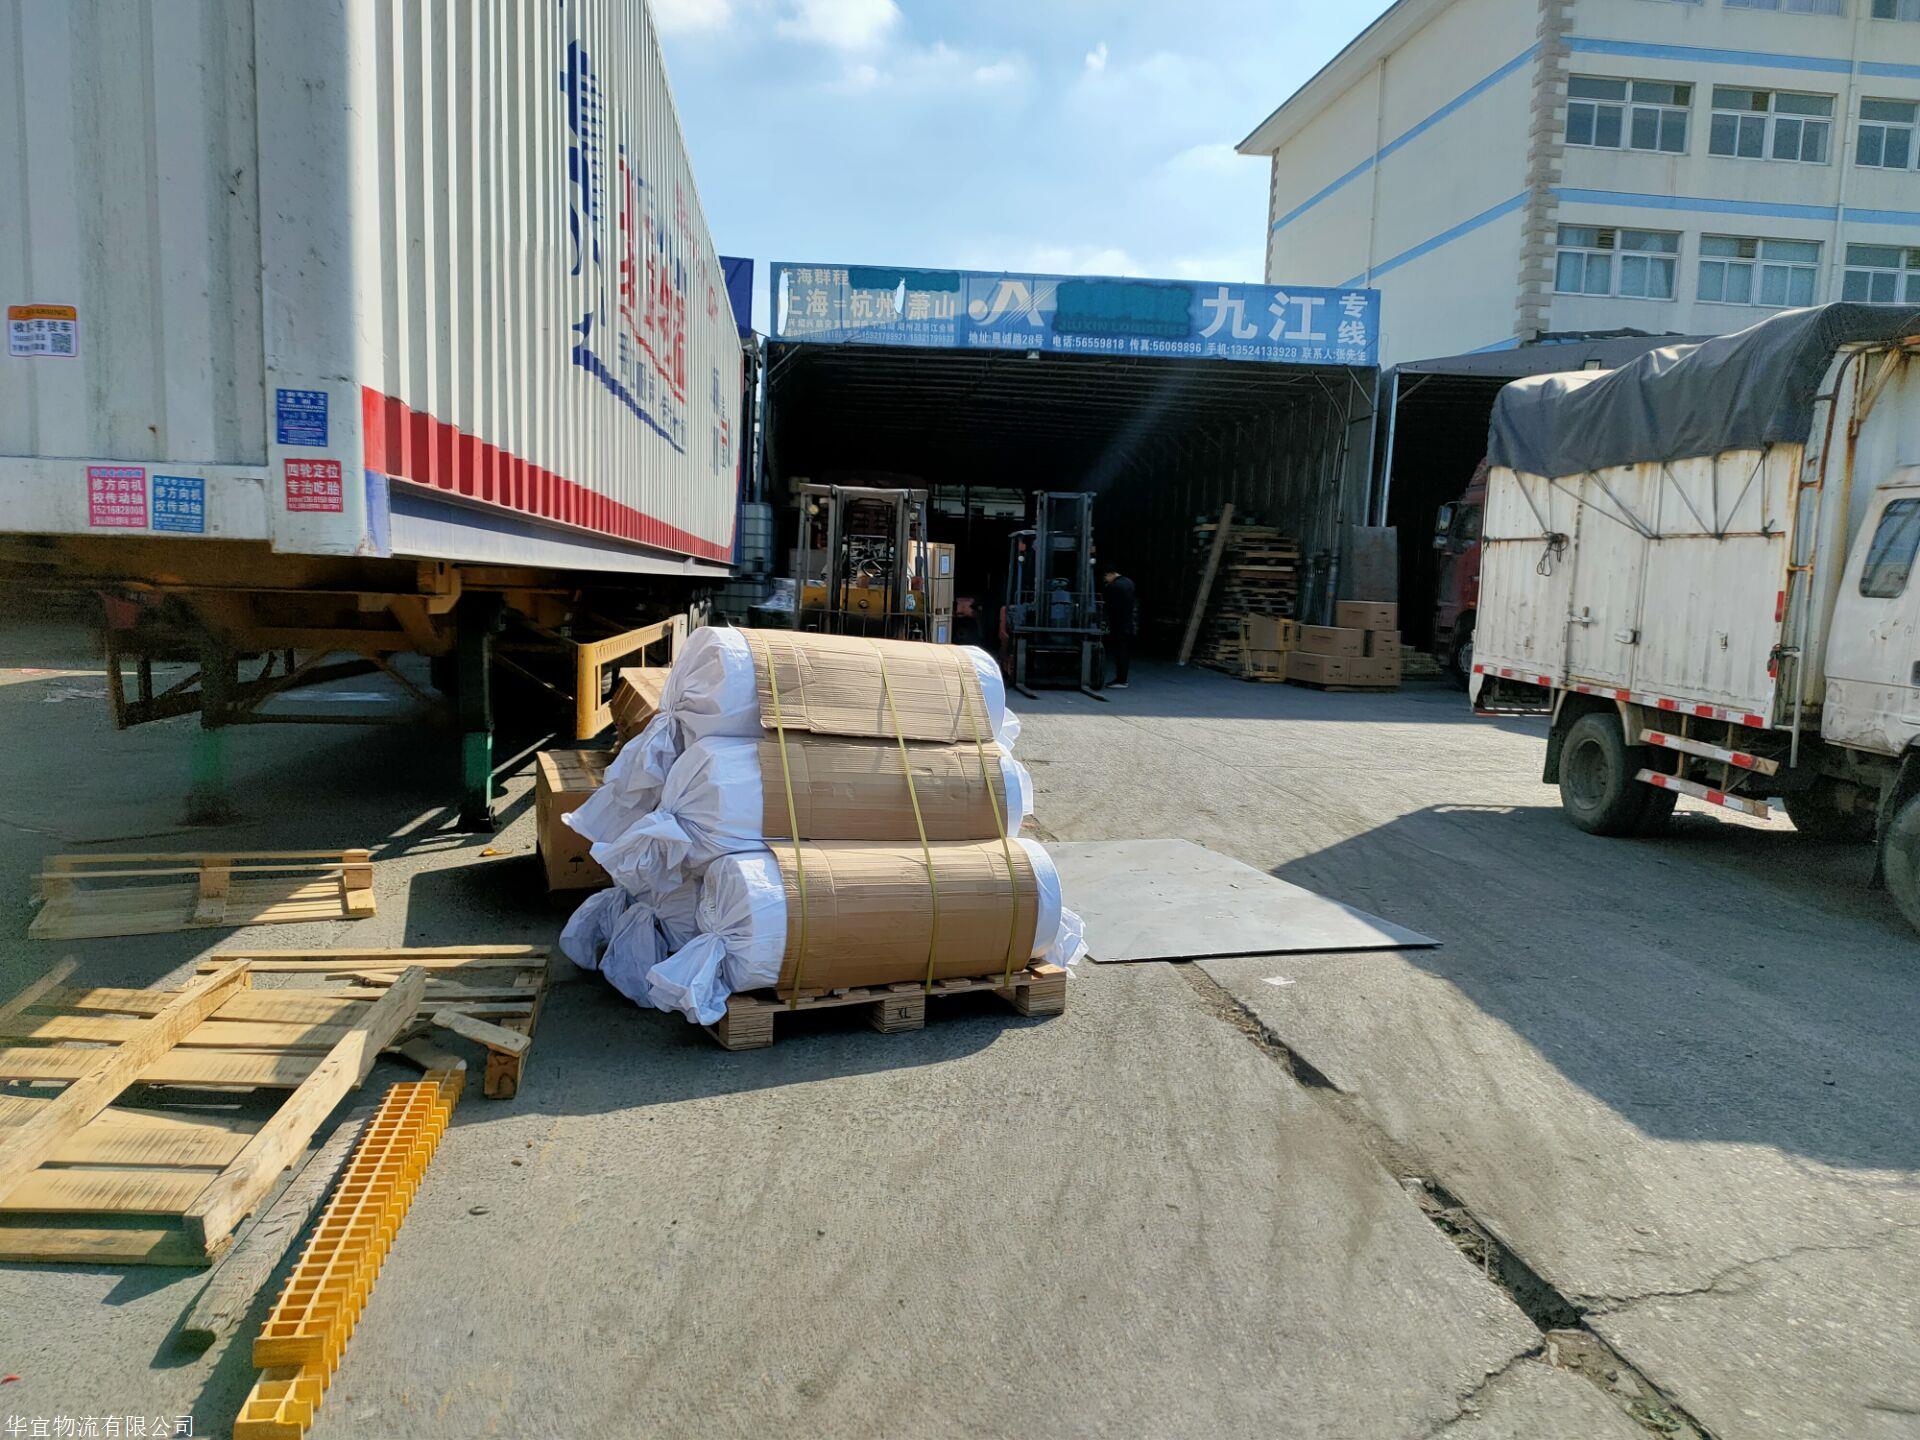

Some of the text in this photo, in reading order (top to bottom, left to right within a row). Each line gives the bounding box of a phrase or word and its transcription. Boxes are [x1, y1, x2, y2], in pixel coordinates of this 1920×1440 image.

[907, 292, 955, 321] 萧山
[1200, 286, 1327, 341] 九江
[1337, 292, 1368, 346] 专线
[287, 463, 340, 478] 四轮定位
[287, 480, 340, 495] 专治吃胎
